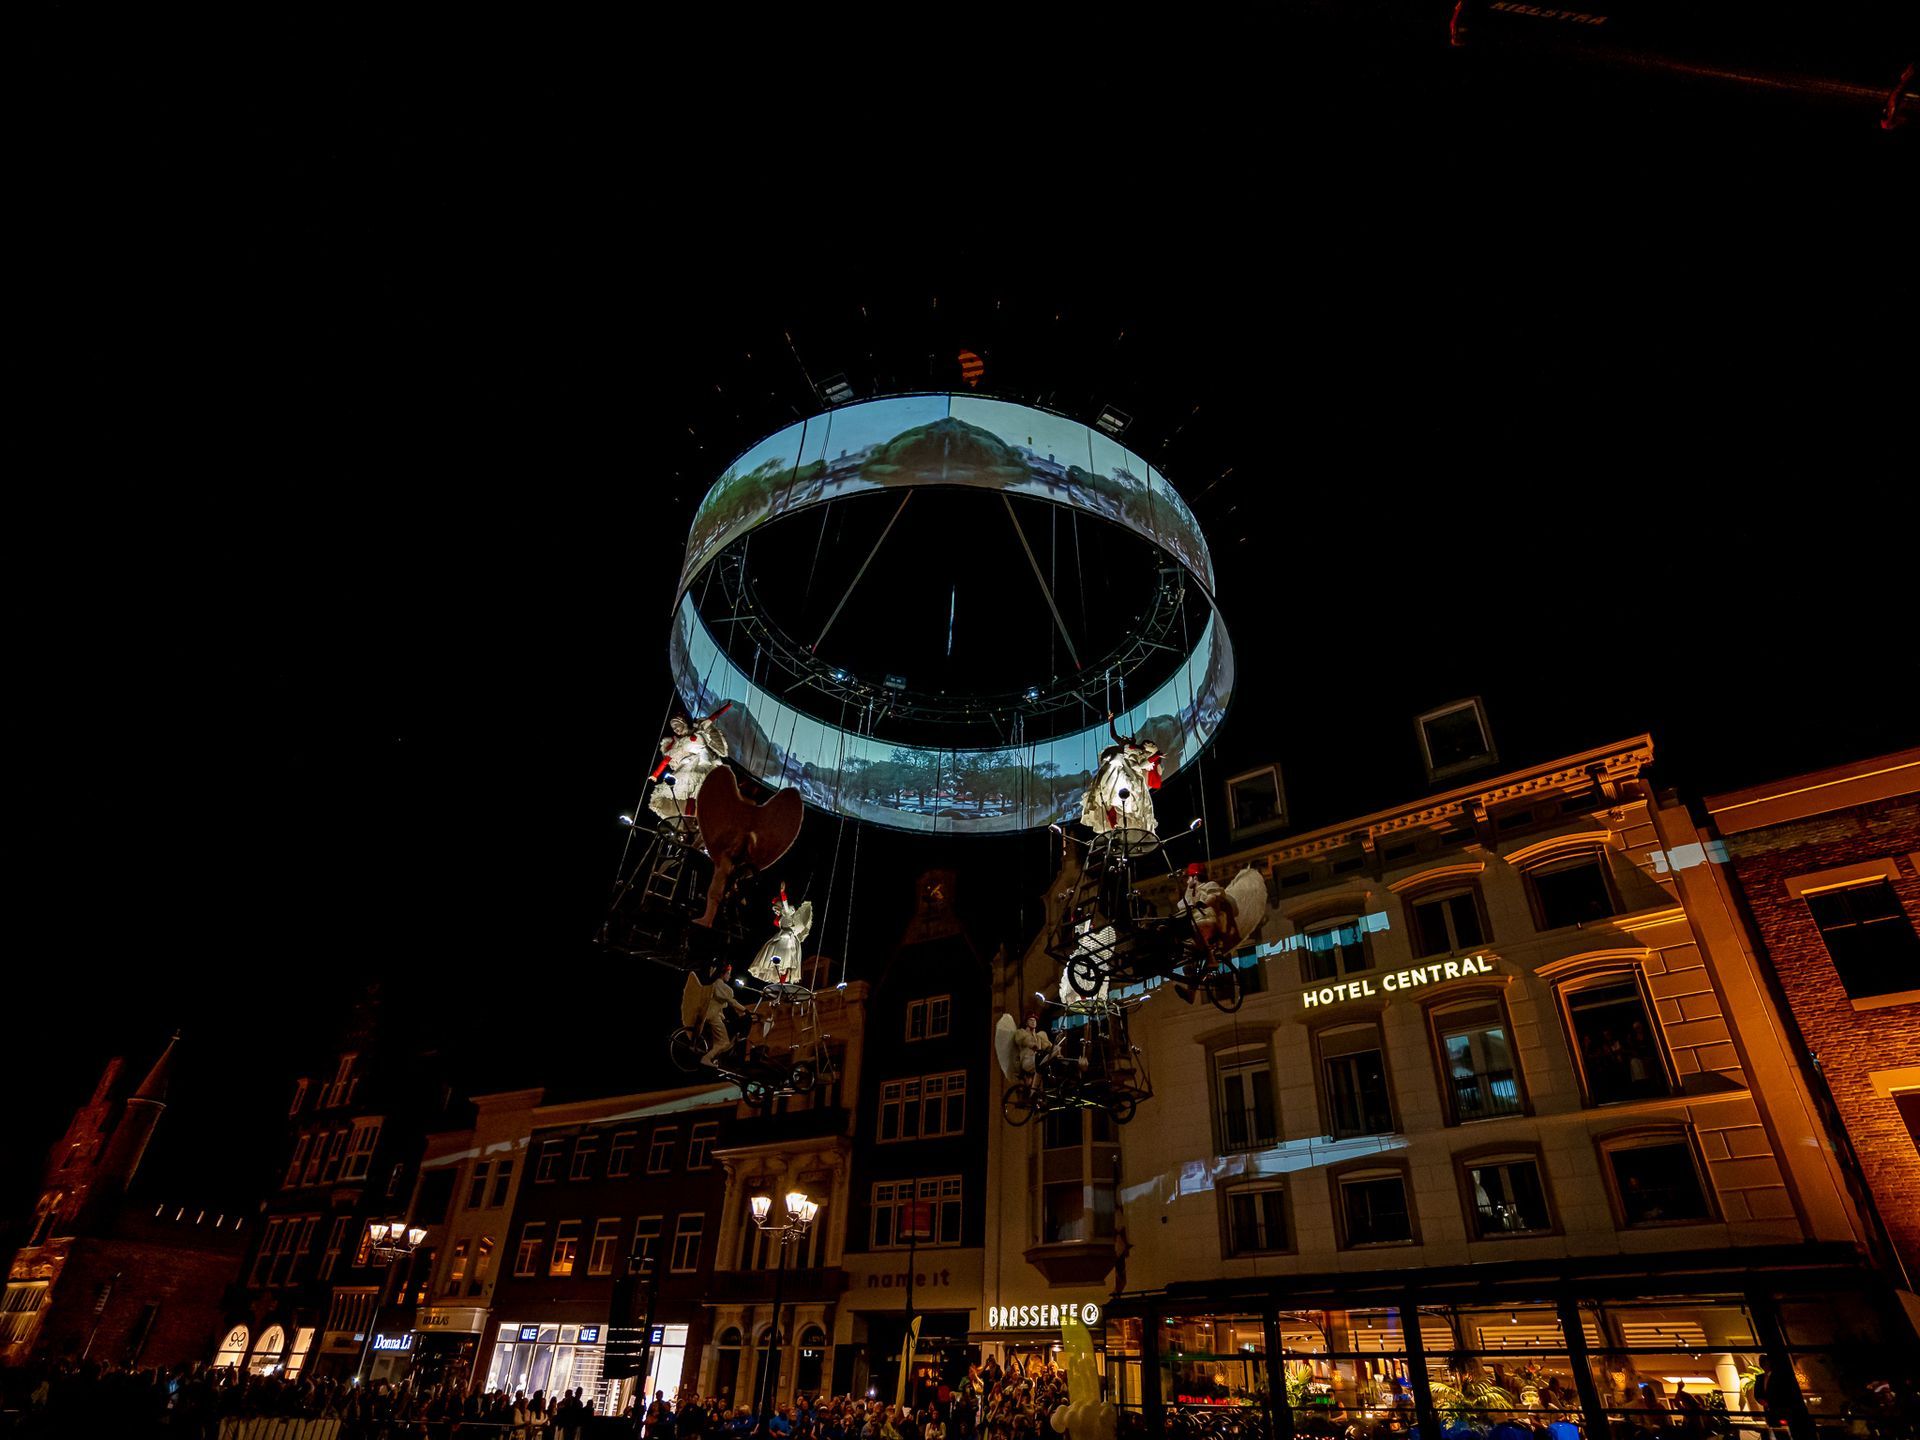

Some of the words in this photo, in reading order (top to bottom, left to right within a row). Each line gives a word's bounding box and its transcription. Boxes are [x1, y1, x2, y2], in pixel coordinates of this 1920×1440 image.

[1303, 980, 1376, 1009] HOTEL
[1382, 955, 1493, 992] CENTRAL
[868, 1273, 926, 1288] name
[933, 1269, 950, 1286] it
[988, 1303, 1078, 1328] BRASSERIE
[374, 1334, 401, 1349] Donna
[400, 1334, 413, 1350] Li
[521, 1328, 538, 1340] WE
[580, 1329, 597, 1341] WE
